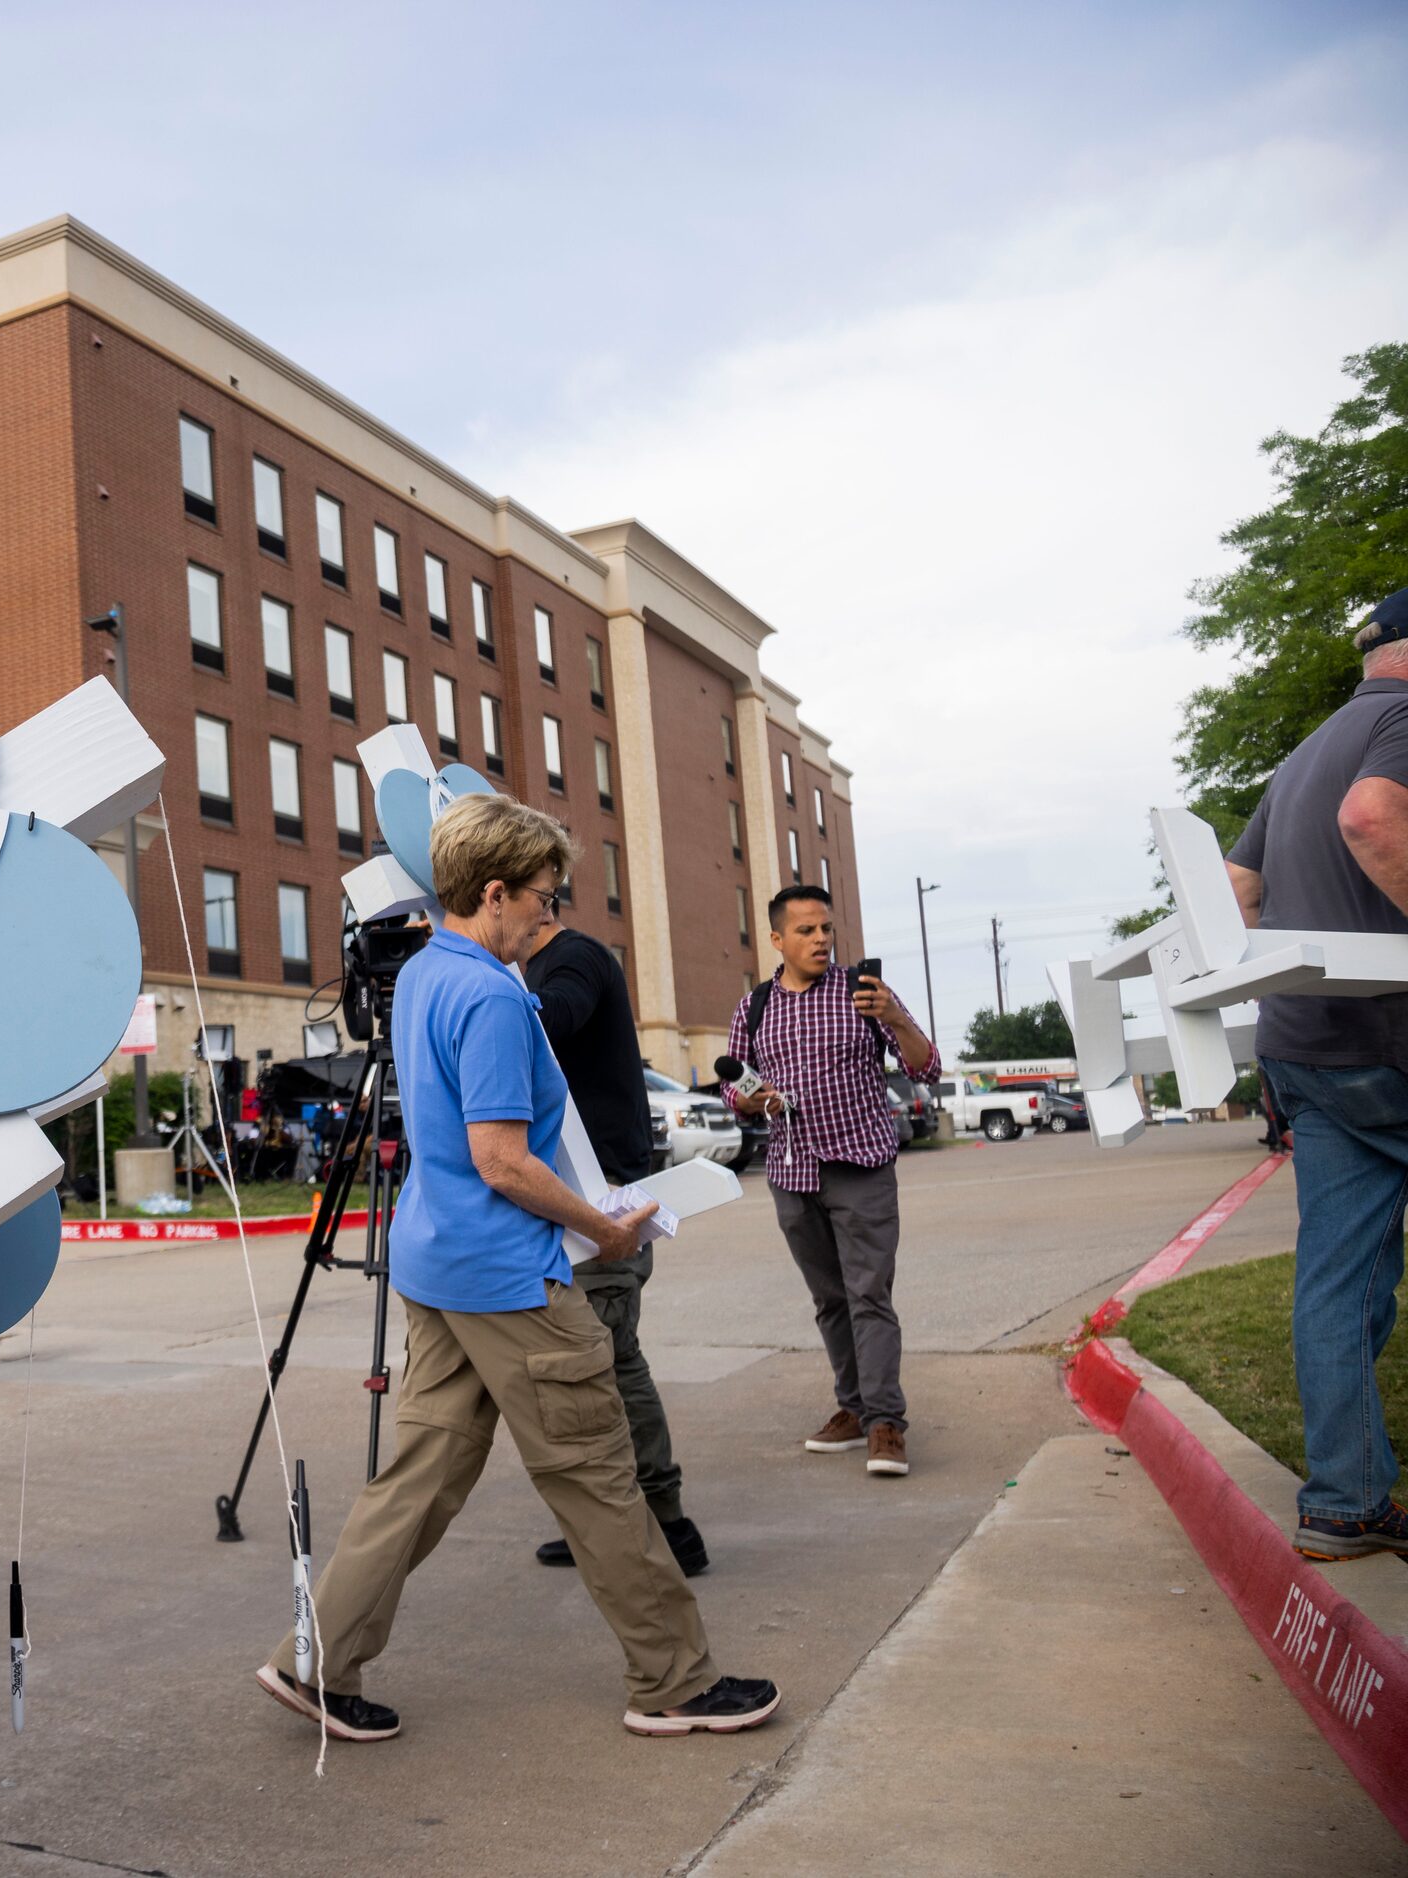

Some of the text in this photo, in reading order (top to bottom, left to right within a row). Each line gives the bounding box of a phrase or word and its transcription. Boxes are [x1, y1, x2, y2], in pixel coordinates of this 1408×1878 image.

[1006, 1066, 1051, 1075] U-HAUL
[740, 1078, 757, 1094] 23
[61, 1223, 219, 1239] IRE LANE NO PARKING
[1272, 1582, 1385, 1730] FIRE LANE
